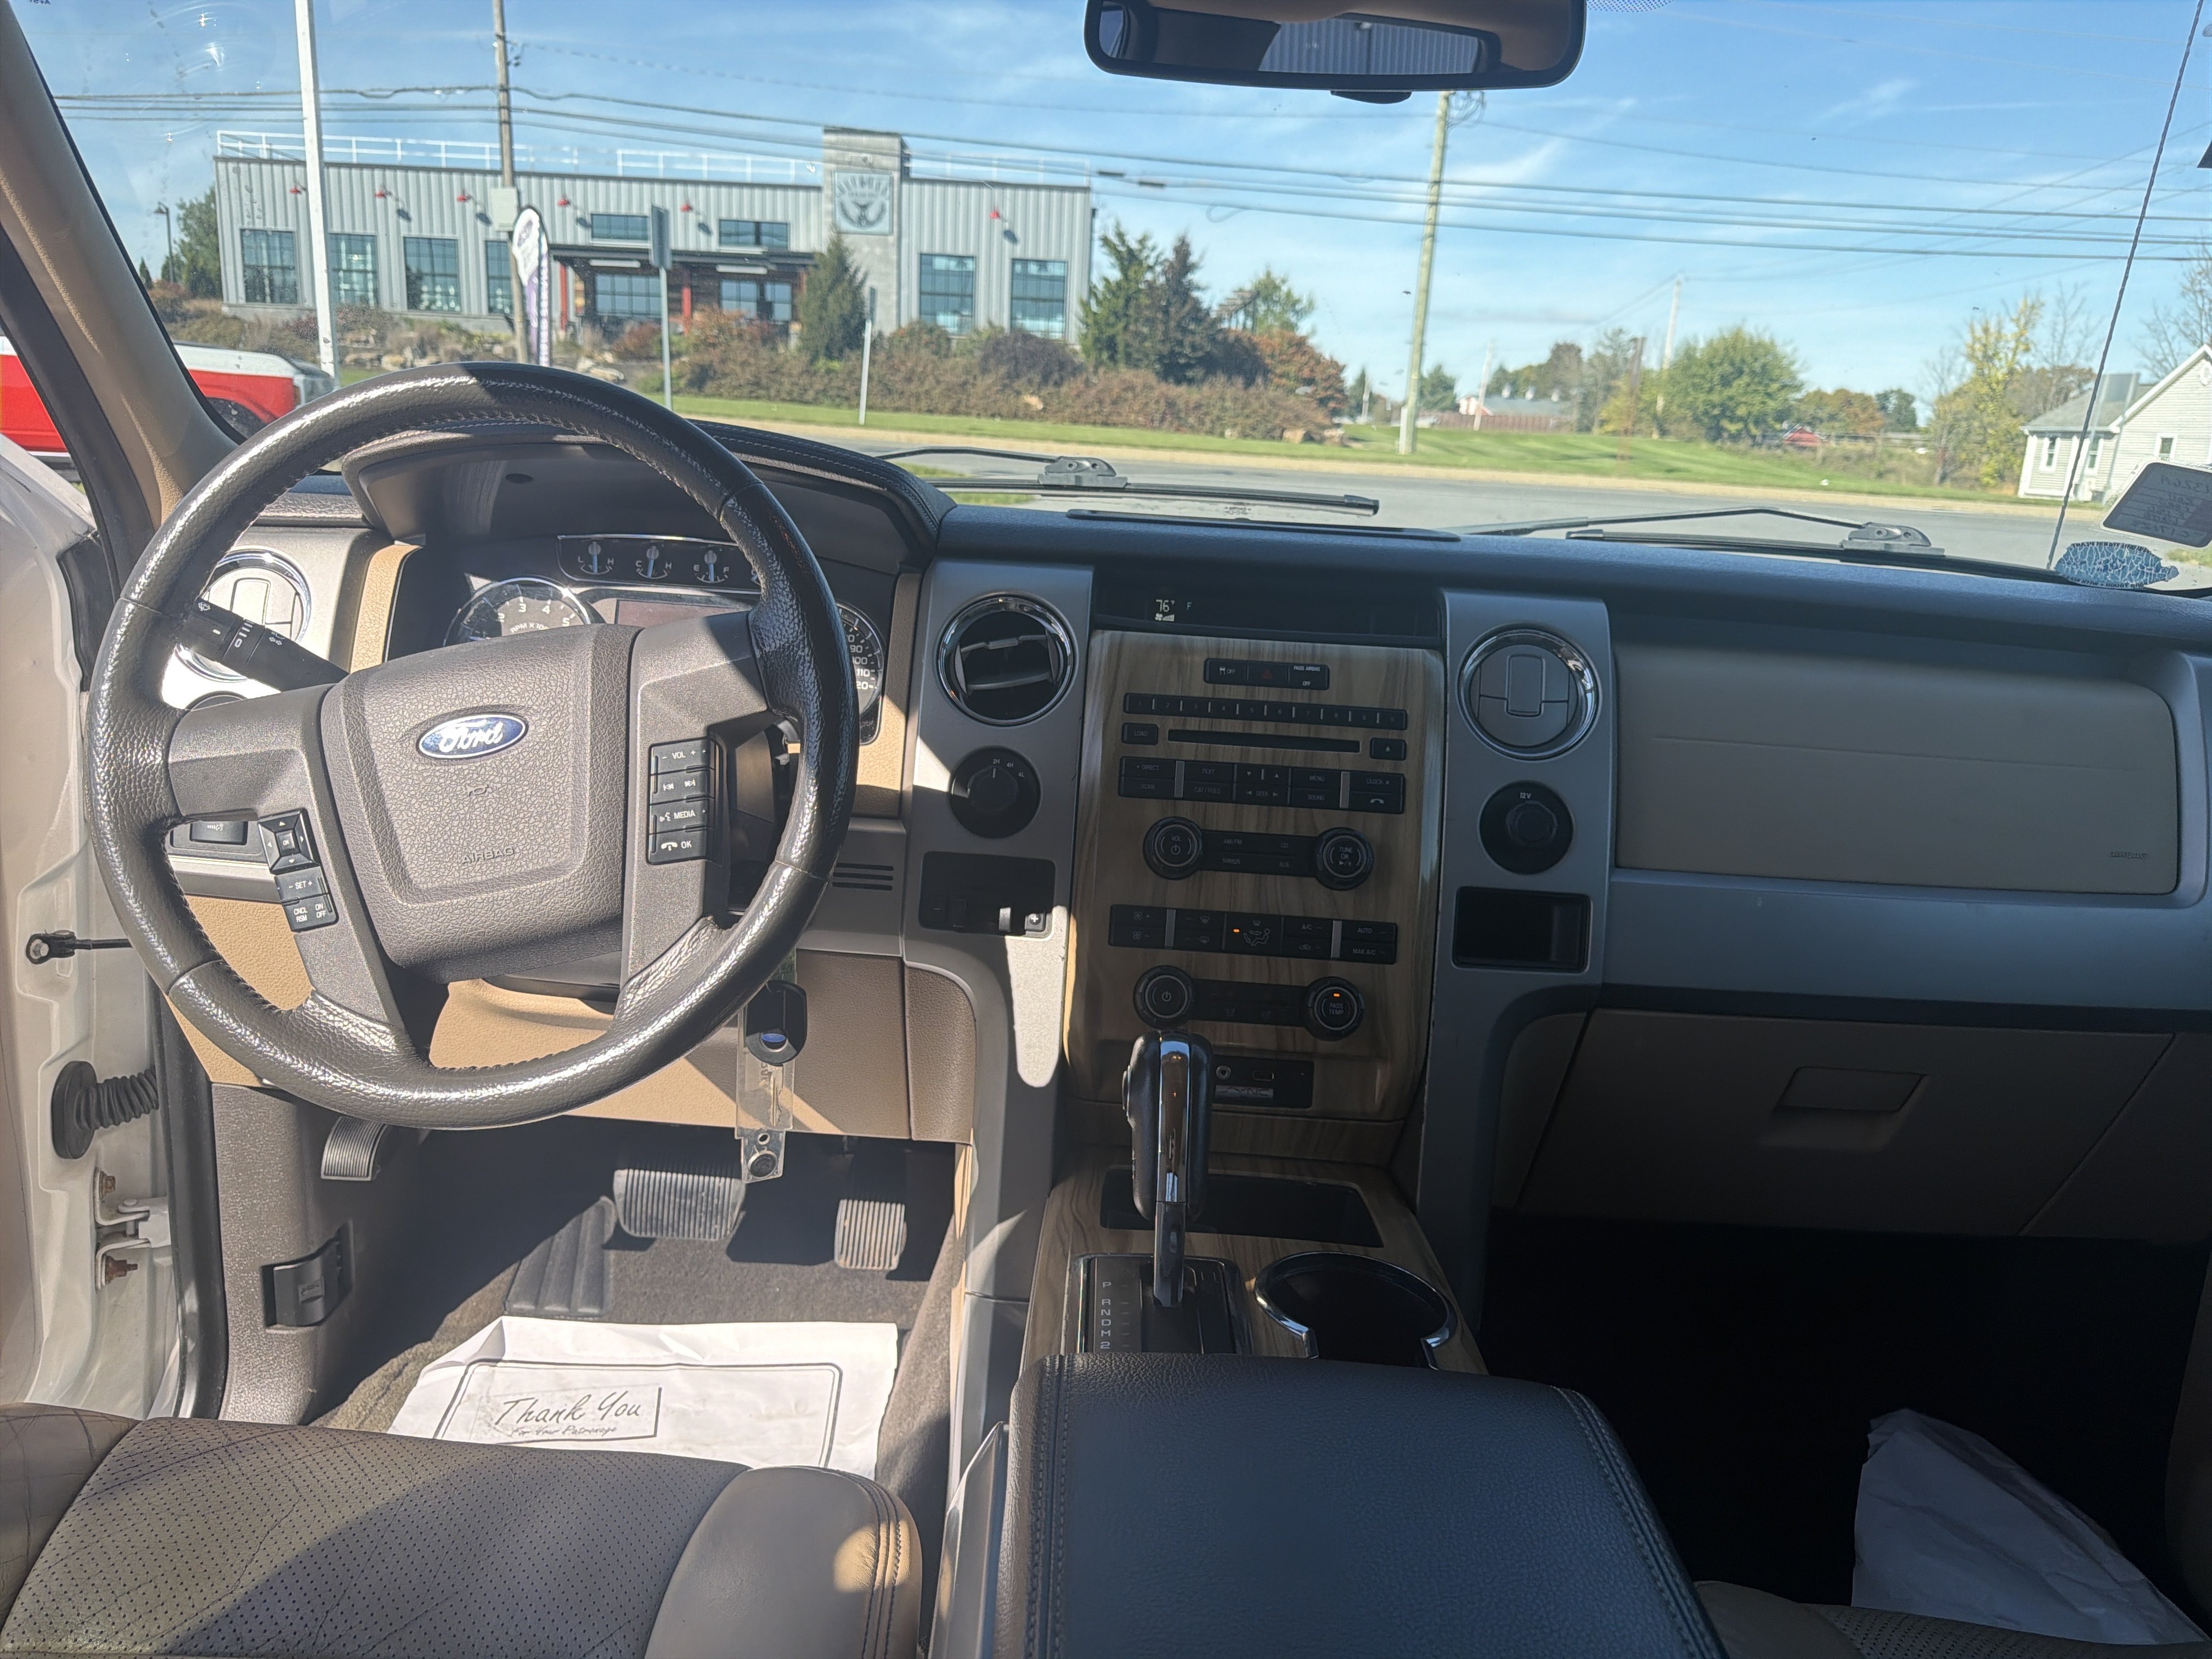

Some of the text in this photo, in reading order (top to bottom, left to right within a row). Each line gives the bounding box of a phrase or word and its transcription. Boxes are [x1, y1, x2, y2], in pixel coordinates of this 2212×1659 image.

[518, 603, 527, 612] 3
[542, 605, 550, 614] 4
[498, 613, 505, 622] 2
[562, 618, 570, 627] 5
[510, 623, 527, 634] RPM
[856, 681, 868, 690] 20
[439, 720, 504, 753] Ford
[674, 811, 696, 819] MEDIA
[462, 845, 515, 865] AIRBAG
[295, 881, 307, 890] SET
[294, 907, 308, 916] CNCL
[316, 910, 326, 918] OFF
[494, 1391, 641, 1425] Thank You
